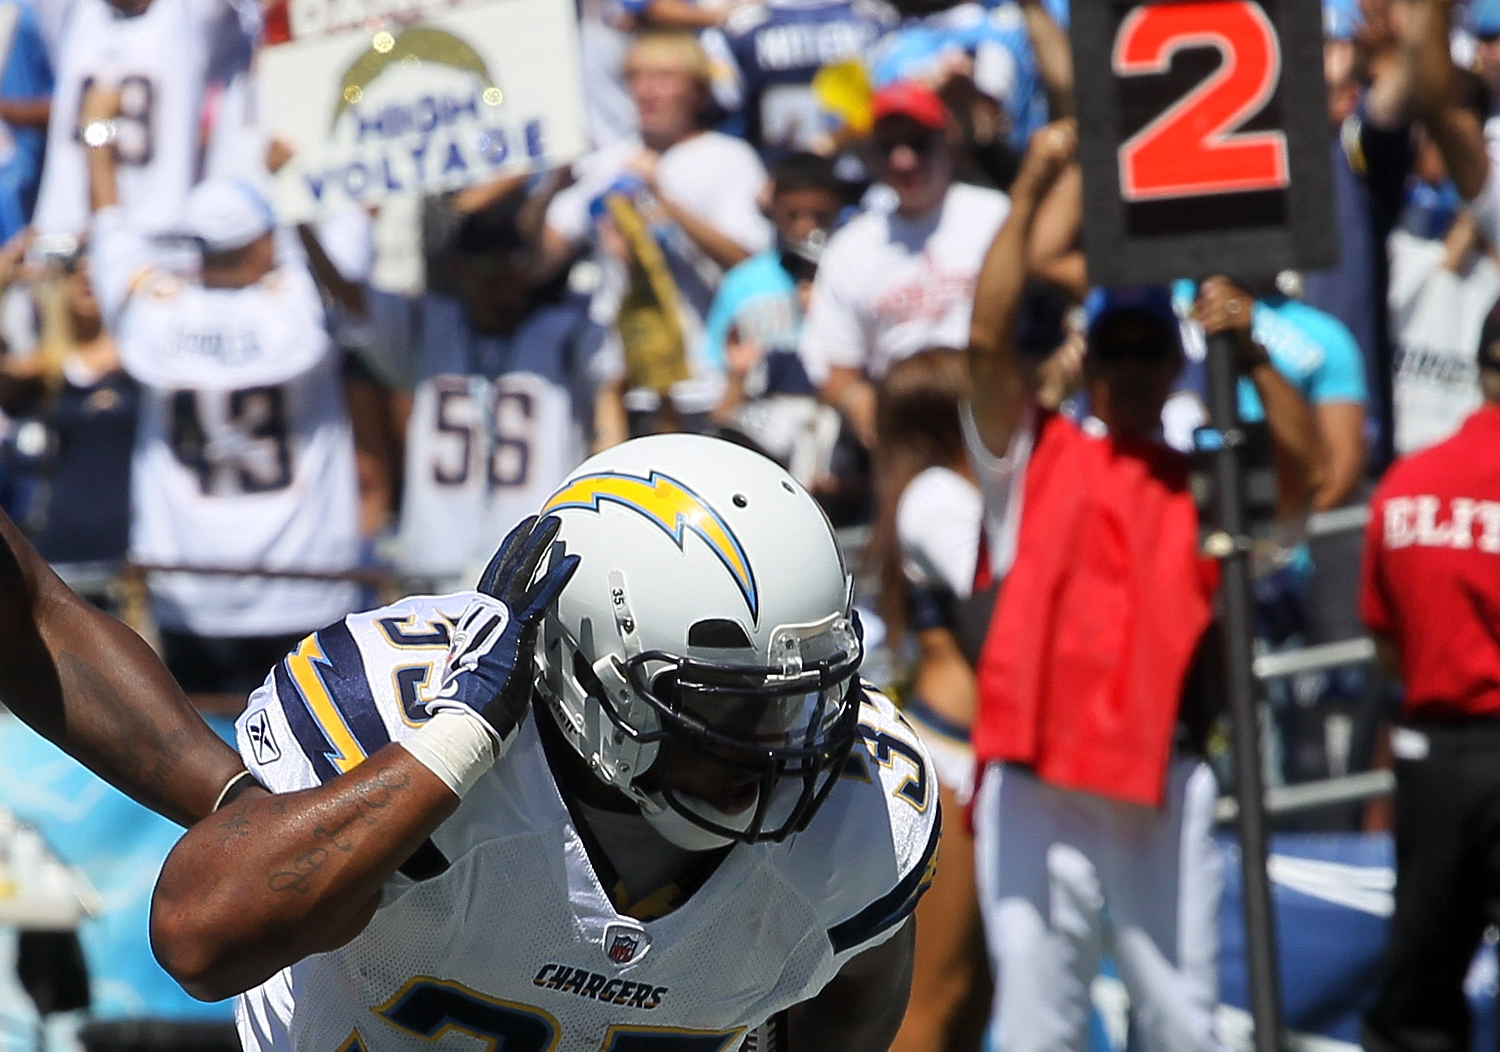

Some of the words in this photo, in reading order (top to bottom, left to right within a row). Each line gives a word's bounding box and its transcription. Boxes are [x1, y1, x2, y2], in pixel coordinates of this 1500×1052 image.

[1112, 0, 1290, 199] 2
[433, 377, 535, 491] 56
[611, 588, 625, 606] 35
[532, 963, 669, 1010] CHARGERS
